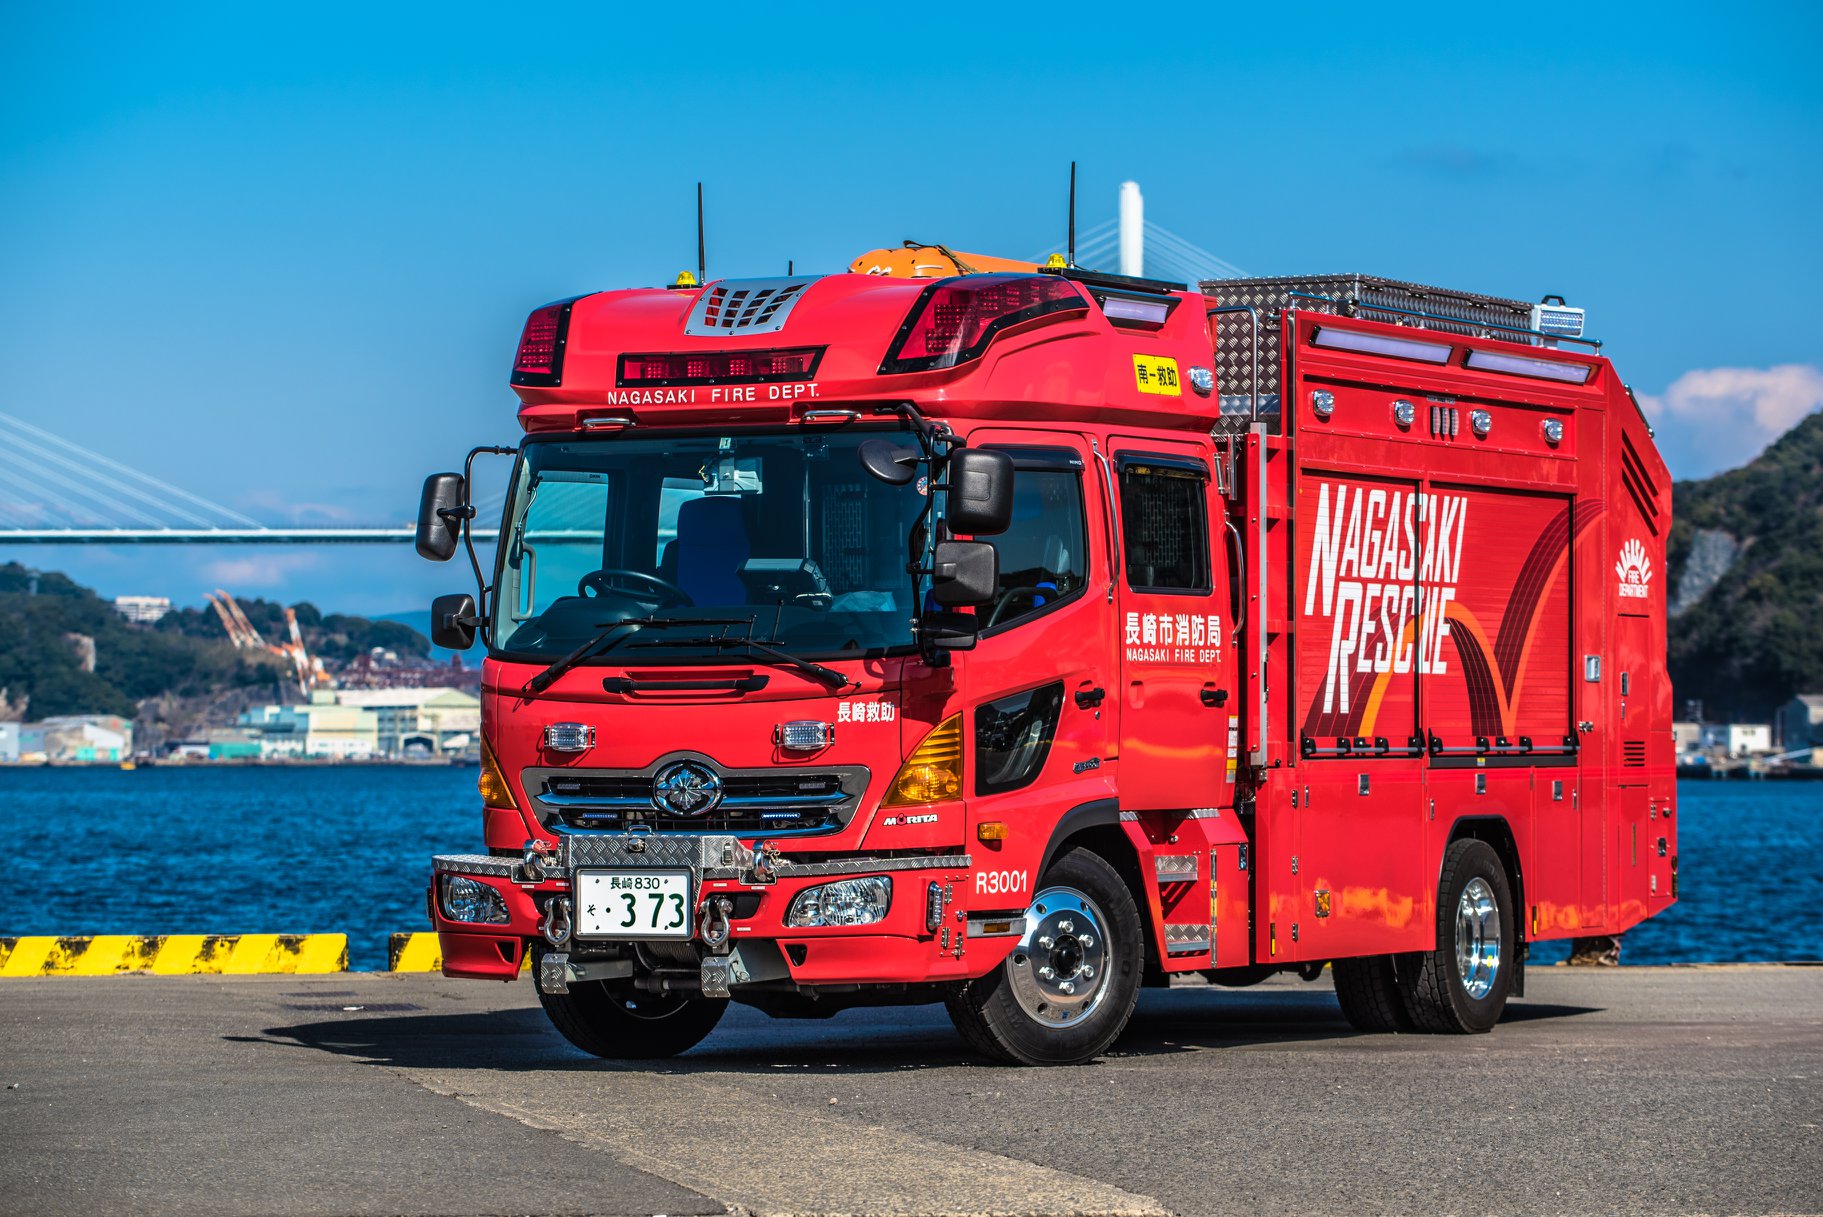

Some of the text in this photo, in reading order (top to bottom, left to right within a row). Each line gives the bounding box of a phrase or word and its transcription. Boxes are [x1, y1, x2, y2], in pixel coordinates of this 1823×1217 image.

[608, 383, 820, 405] NAGASAKI FIRE DEPT.
[1304, 483, 1468, 617] NAGASAKI
[1628, 570, 1640, 583] FIRE
[1125, 612, 1221, 647] 長崎市消防局
[1126, 648, 1222, 663] NAGASAKI FIRE DEPT.
[1322, 581, 1455, 714] RESCUE
[837, 701, 895, 722] 長崎救助
[882, 813, 938, 826] MORITA
[976, 869, 1027, 895] R3001
